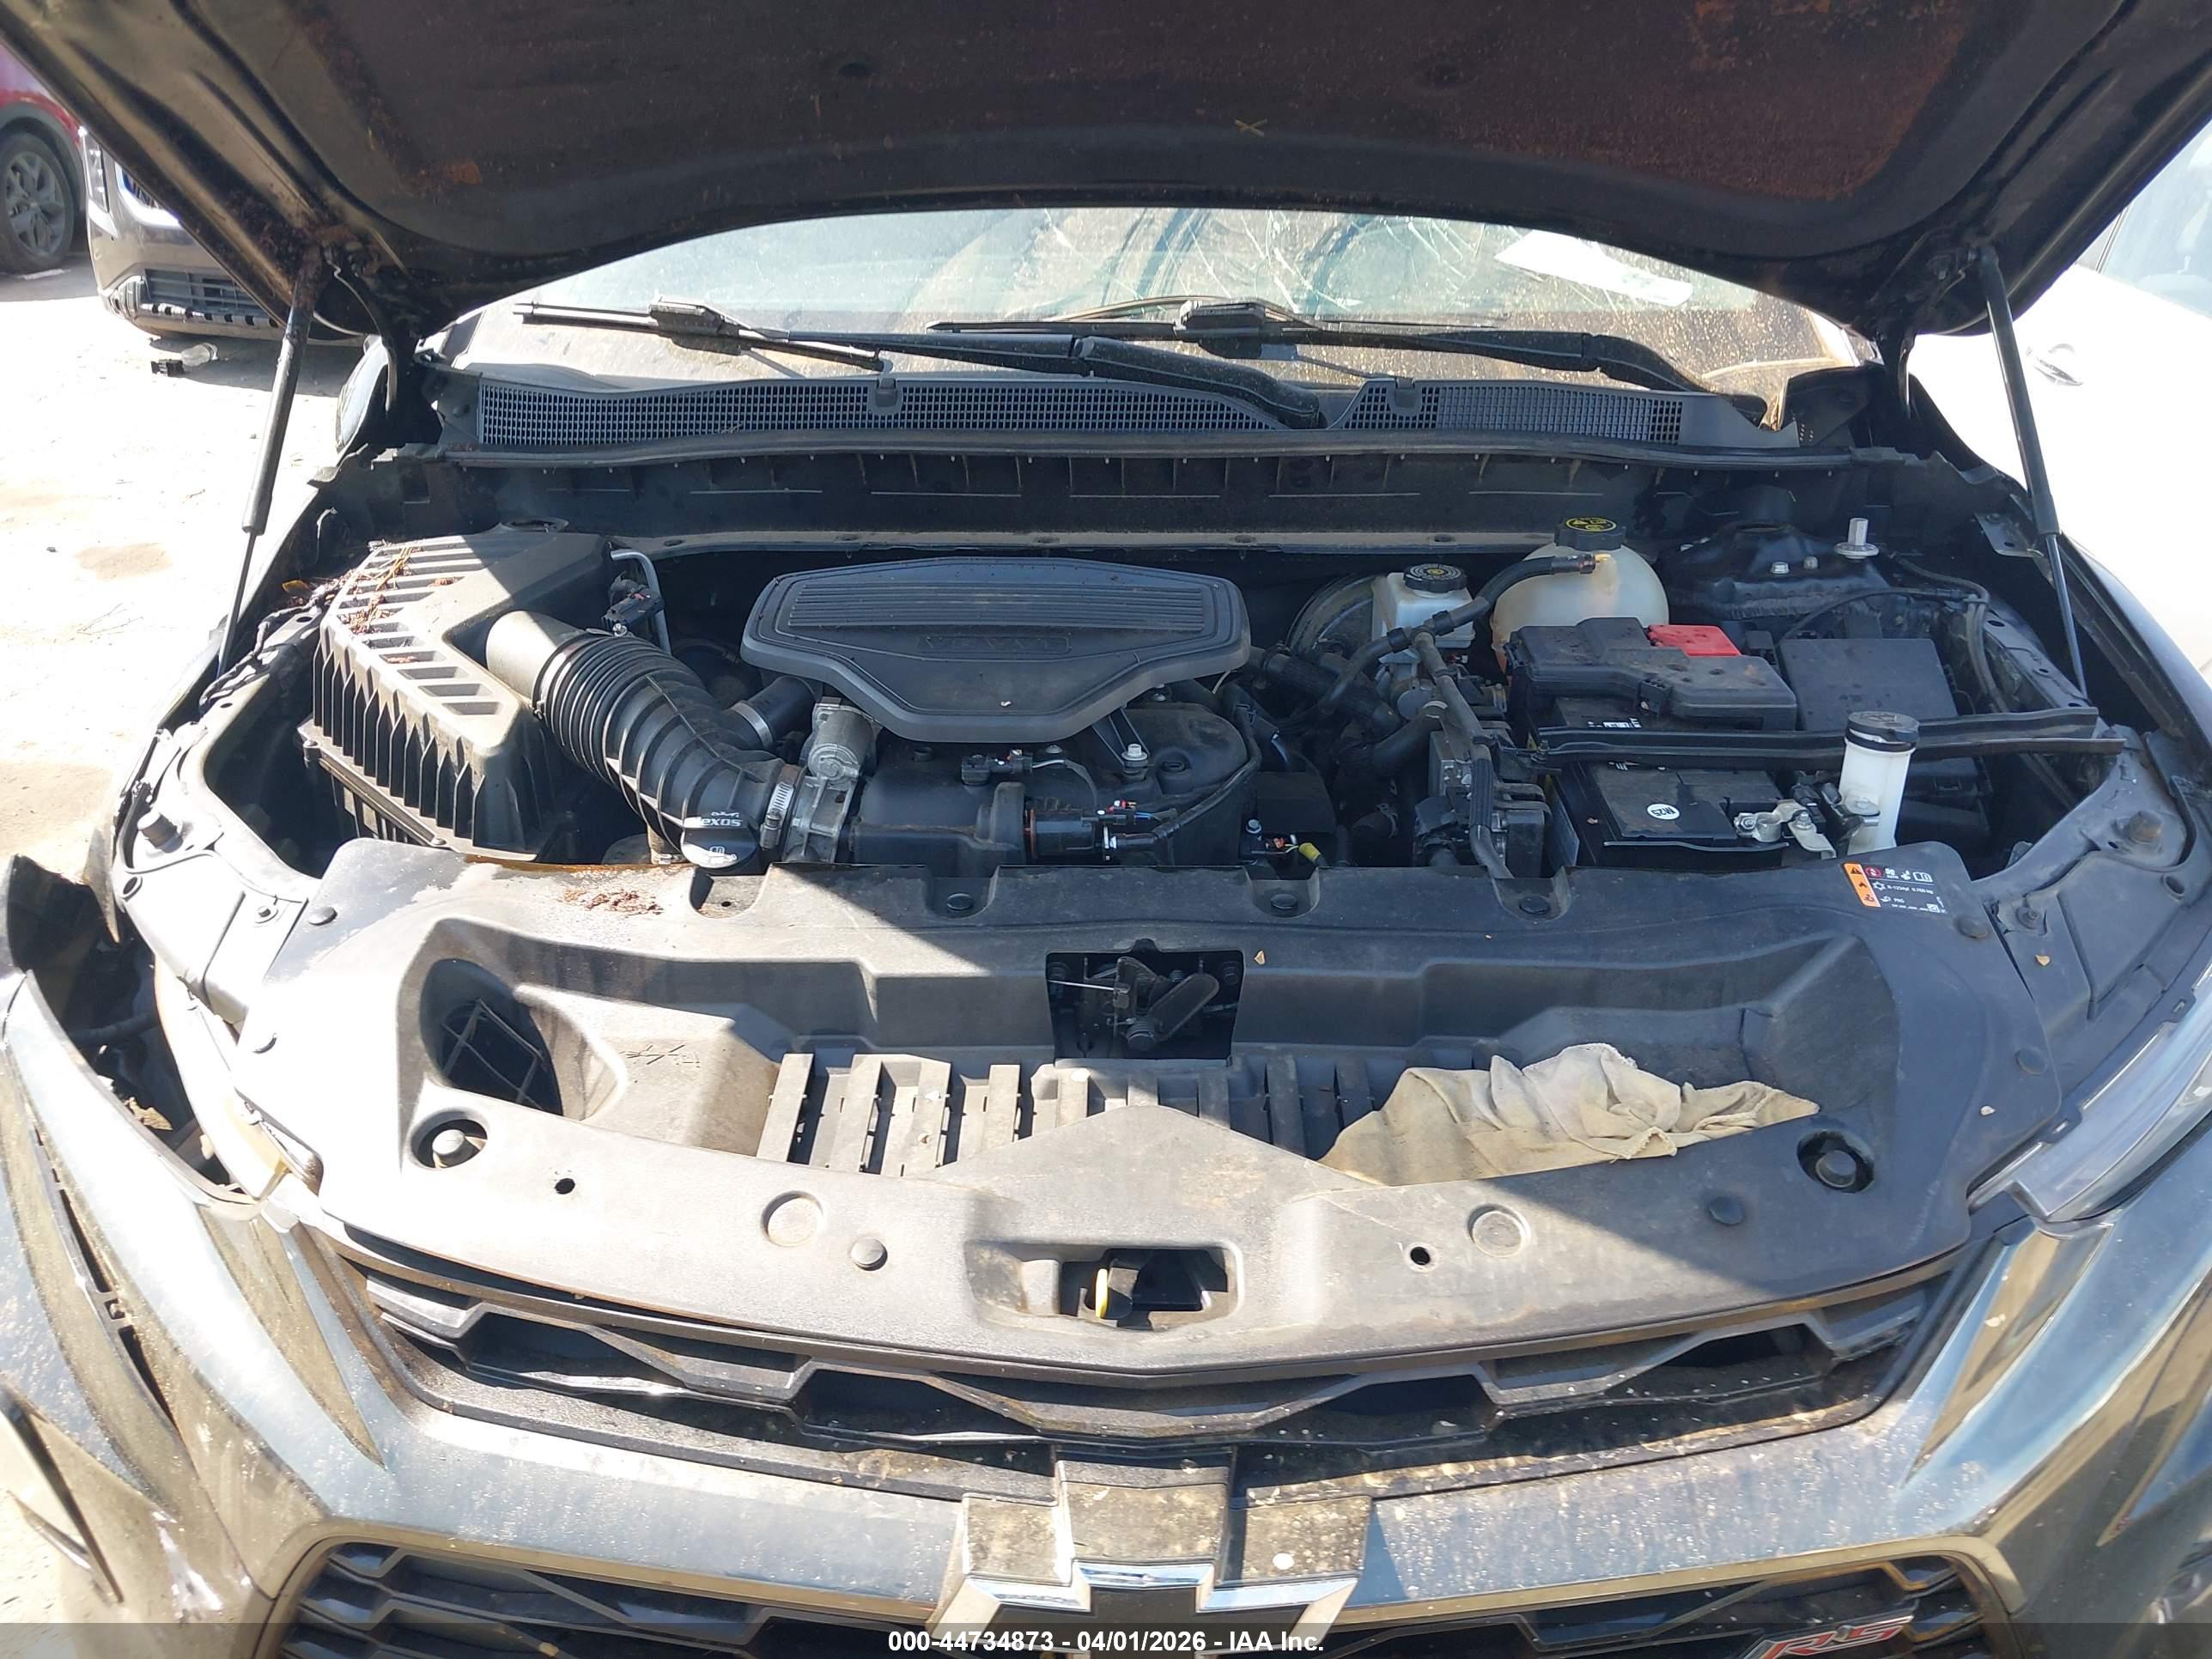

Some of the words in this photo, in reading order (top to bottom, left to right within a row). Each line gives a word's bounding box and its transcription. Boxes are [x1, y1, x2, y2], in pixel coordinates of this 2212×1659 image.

[1650, 807, 1676, 817] M25
[700, 817, 743, 827] exos
[1757, 1615, 1914, 1659] RS
